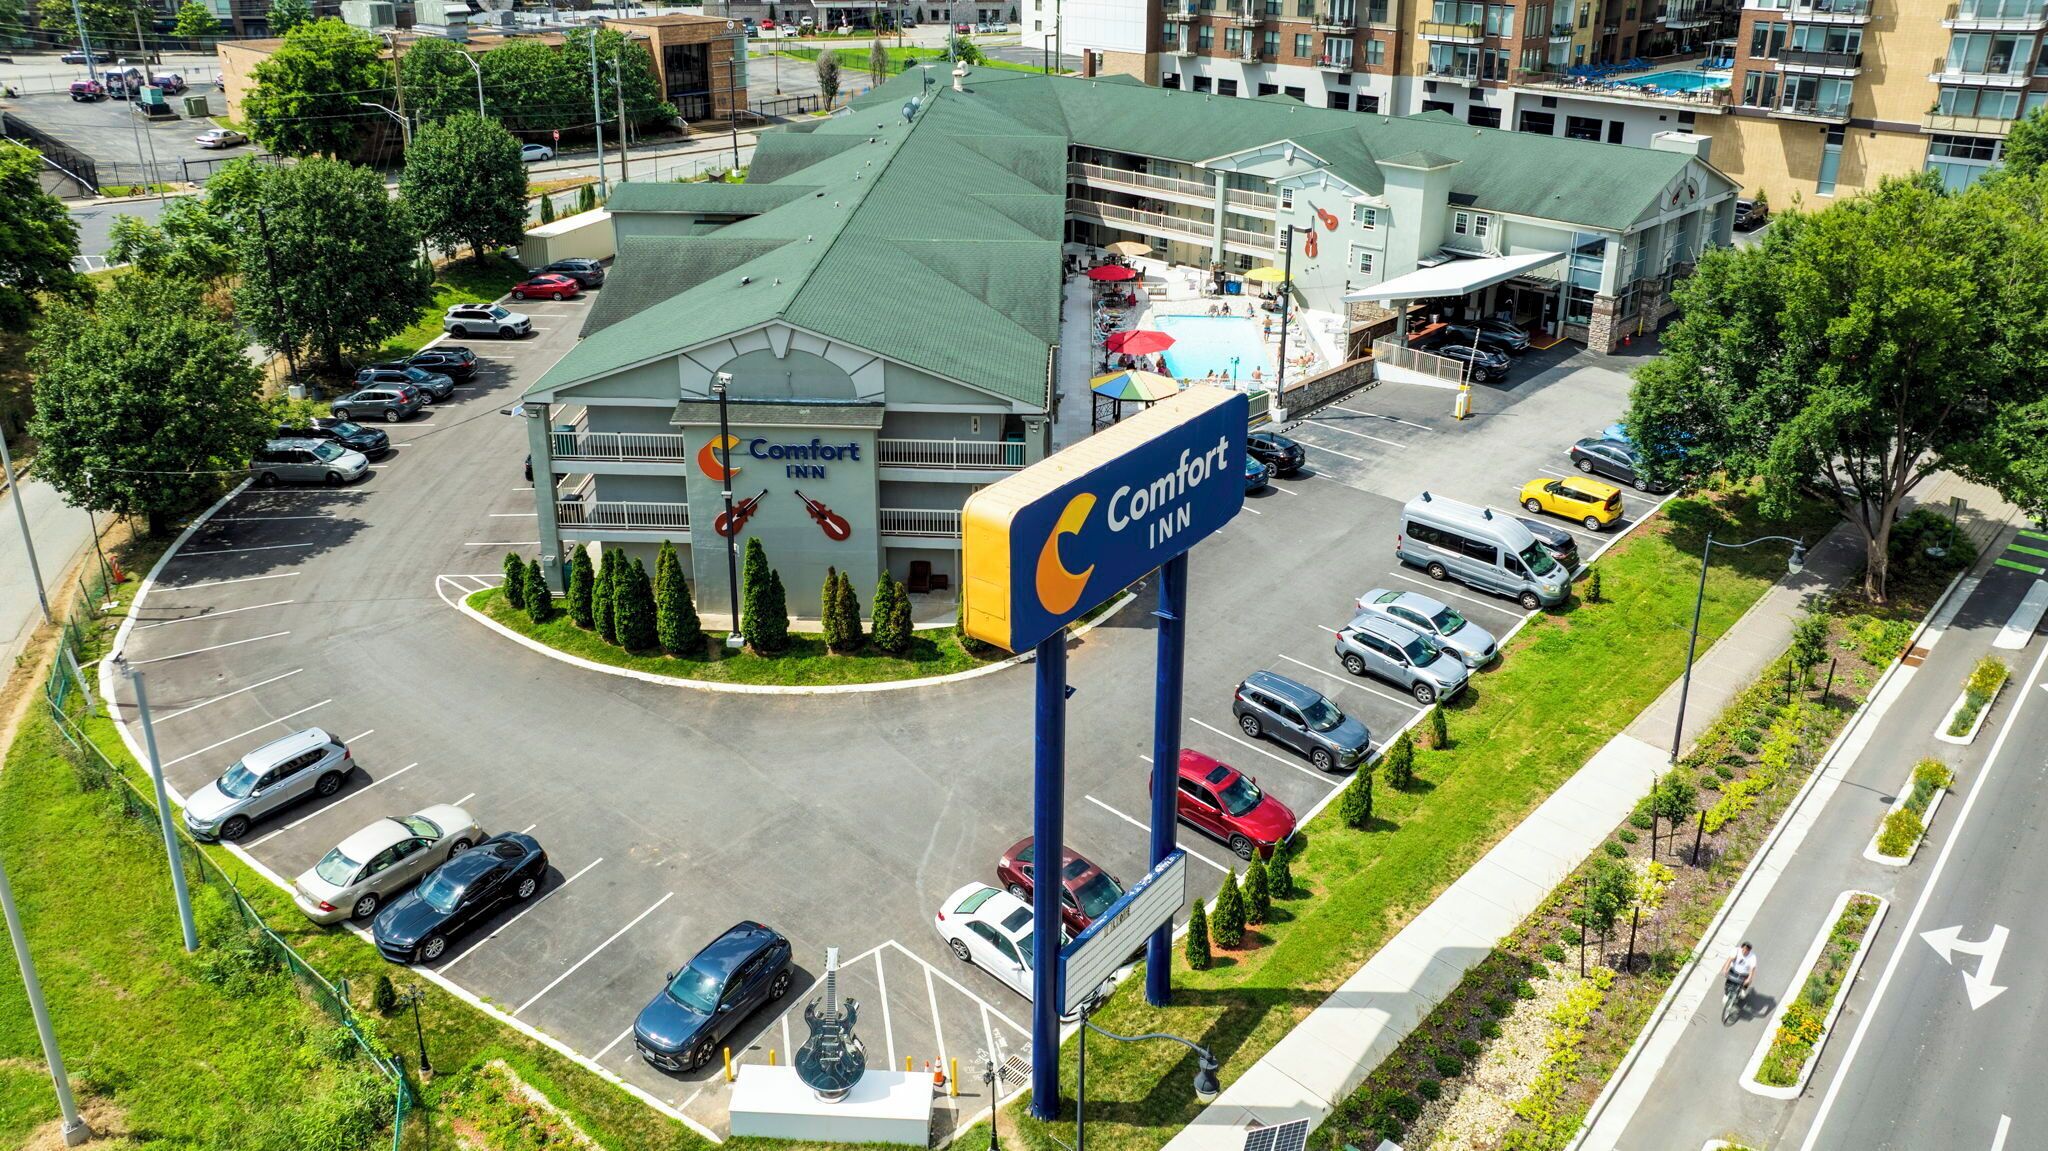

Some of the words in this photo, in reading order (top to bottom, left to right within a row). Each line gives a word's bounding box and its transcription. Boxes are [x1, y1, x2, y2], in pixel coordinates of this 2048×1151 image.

[749, 437, 861, 461] Comfort
[786, 463, 826, 479] INN
[1107, 434, 1229, 533] Comfort
[1149, 501, 1191, 550] INN
